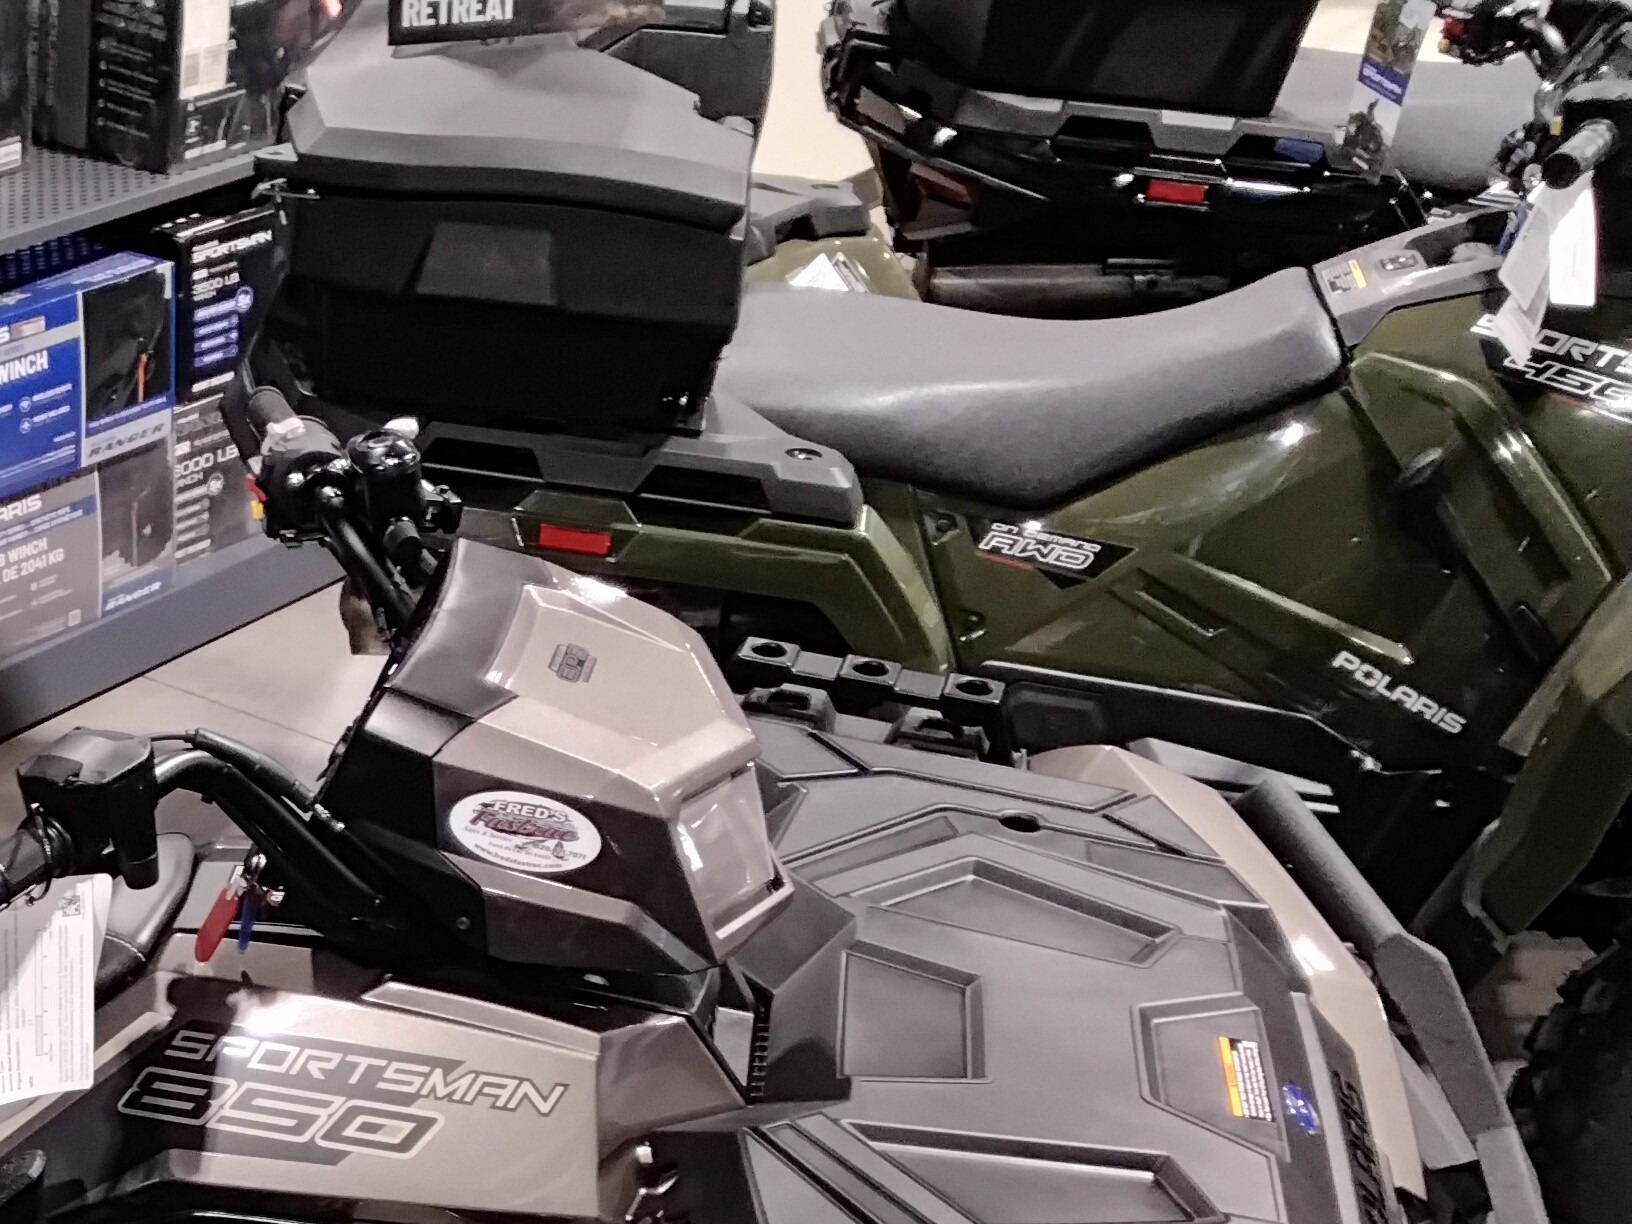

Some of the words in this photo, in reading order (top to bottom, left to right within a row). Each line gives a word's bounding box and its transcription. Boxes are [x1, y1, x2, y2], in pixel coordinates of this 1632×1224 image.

[401, 0, 514, 27] RETREAT
[88, 423, 165, 458] RANGER
[217, 444, 240, 463] LB
[3, 568, 18, 584] DE
[20, 555, 48, 577] 2041
[48, 548, 65, 566] KG
[7, 537, 48, 563] WINCH
[978, 531, 1095, 570] AWD
[1331, 650, 1468, 734] POLARIS
[494, 801, 568, 822] FRED'S
[164, 1029, 571, 1117] SPORTSMAN
[117, 1066, 446, 1160] 850
